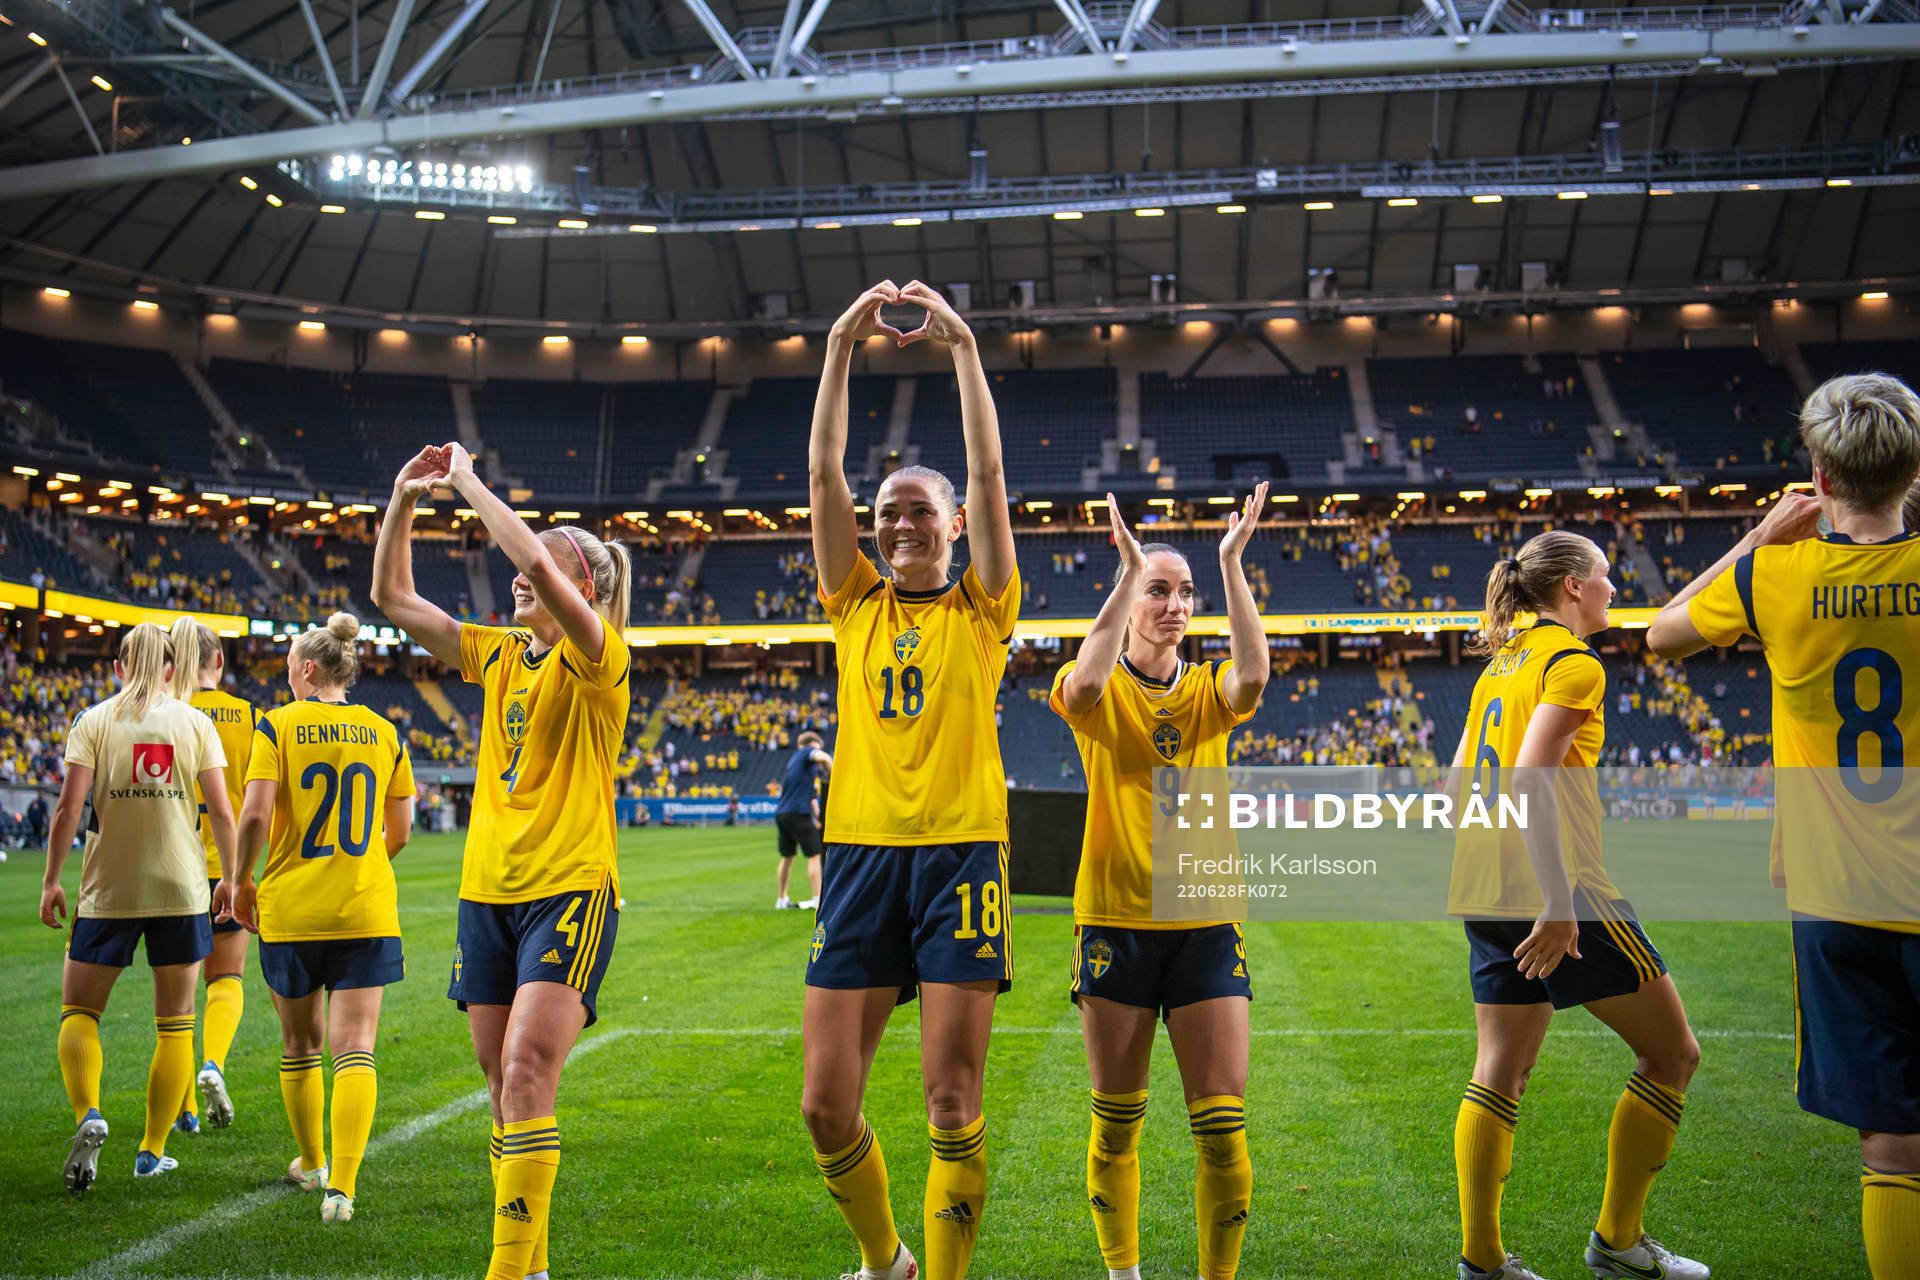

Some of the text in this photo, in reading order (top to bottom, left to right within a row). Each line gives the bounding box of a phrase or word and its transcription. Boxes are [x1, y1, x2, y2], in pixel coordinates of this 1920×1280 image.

[1813, 583, 1920, 619] HURTIG
[879, 665, 925, 719] 18
[296, 723, 378, 745] BENNISON
[1834, 647, 1904, 804] 8
[1472, 697, 1503, 812] 6
[110, 788, 164, 799] SVENSKA
[301, 762, 377, 859] 20
[1159, 765, 1181, 818] 9
[556, 896, 582, 947] 4
[954, 880, 1001, 939] 18
